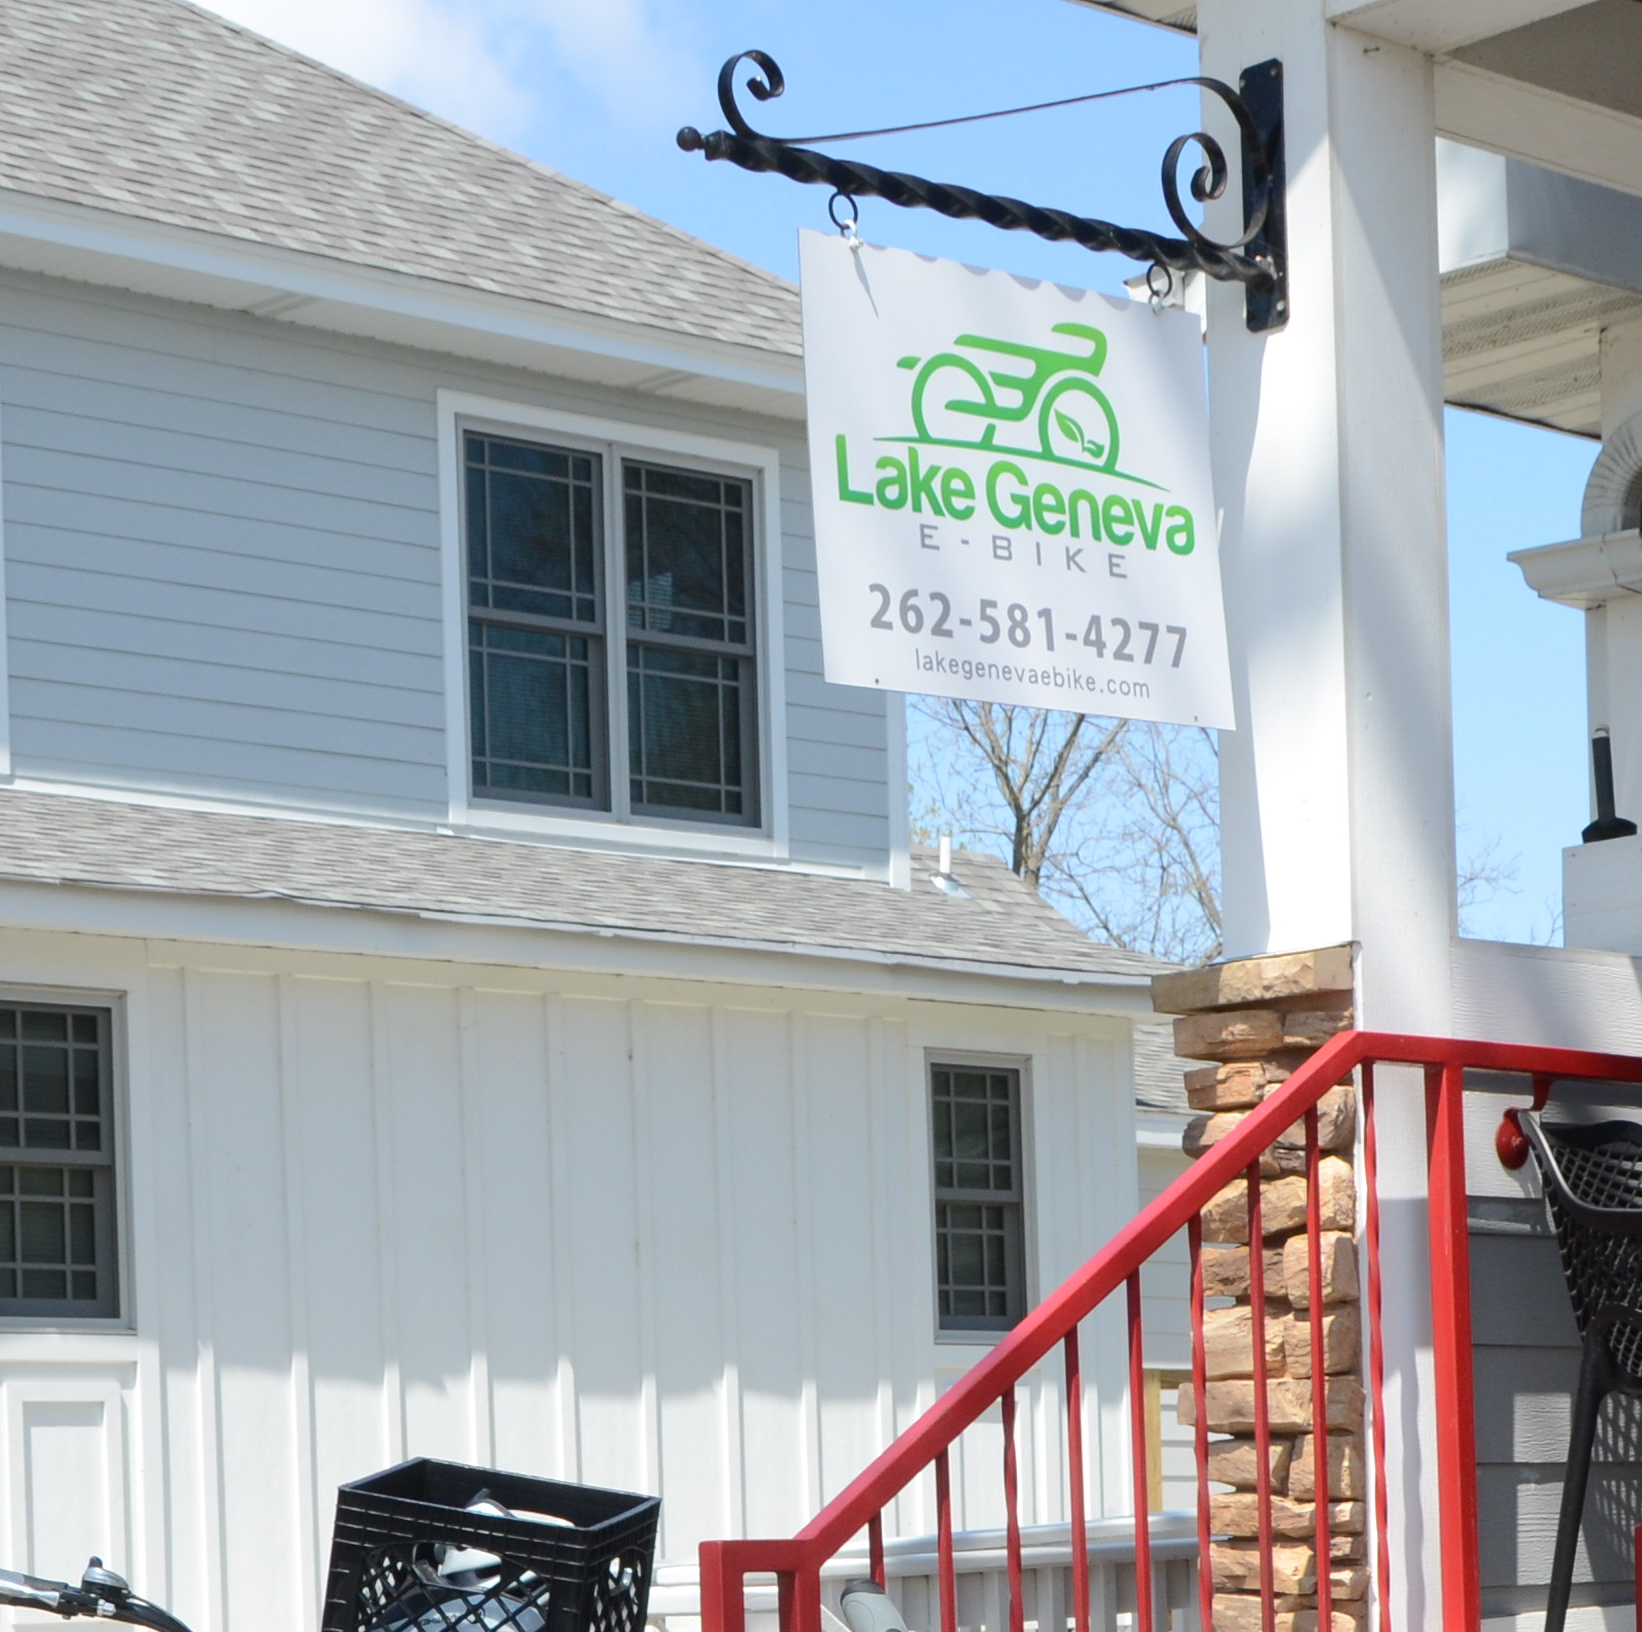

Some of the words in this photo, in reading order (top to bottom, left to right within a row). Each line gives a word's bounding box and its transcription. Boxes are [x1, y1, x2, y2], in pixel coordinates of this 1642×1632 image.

[835, 433, 976, 521] Lake
[985, 460, 1196, 556] Geneva
[919, 524, 1128, 579] E-BIKE
[868, 582, 1188, 669] 262-581-4277
[915, 648, 1150, 699] lakegenevaebike.com
